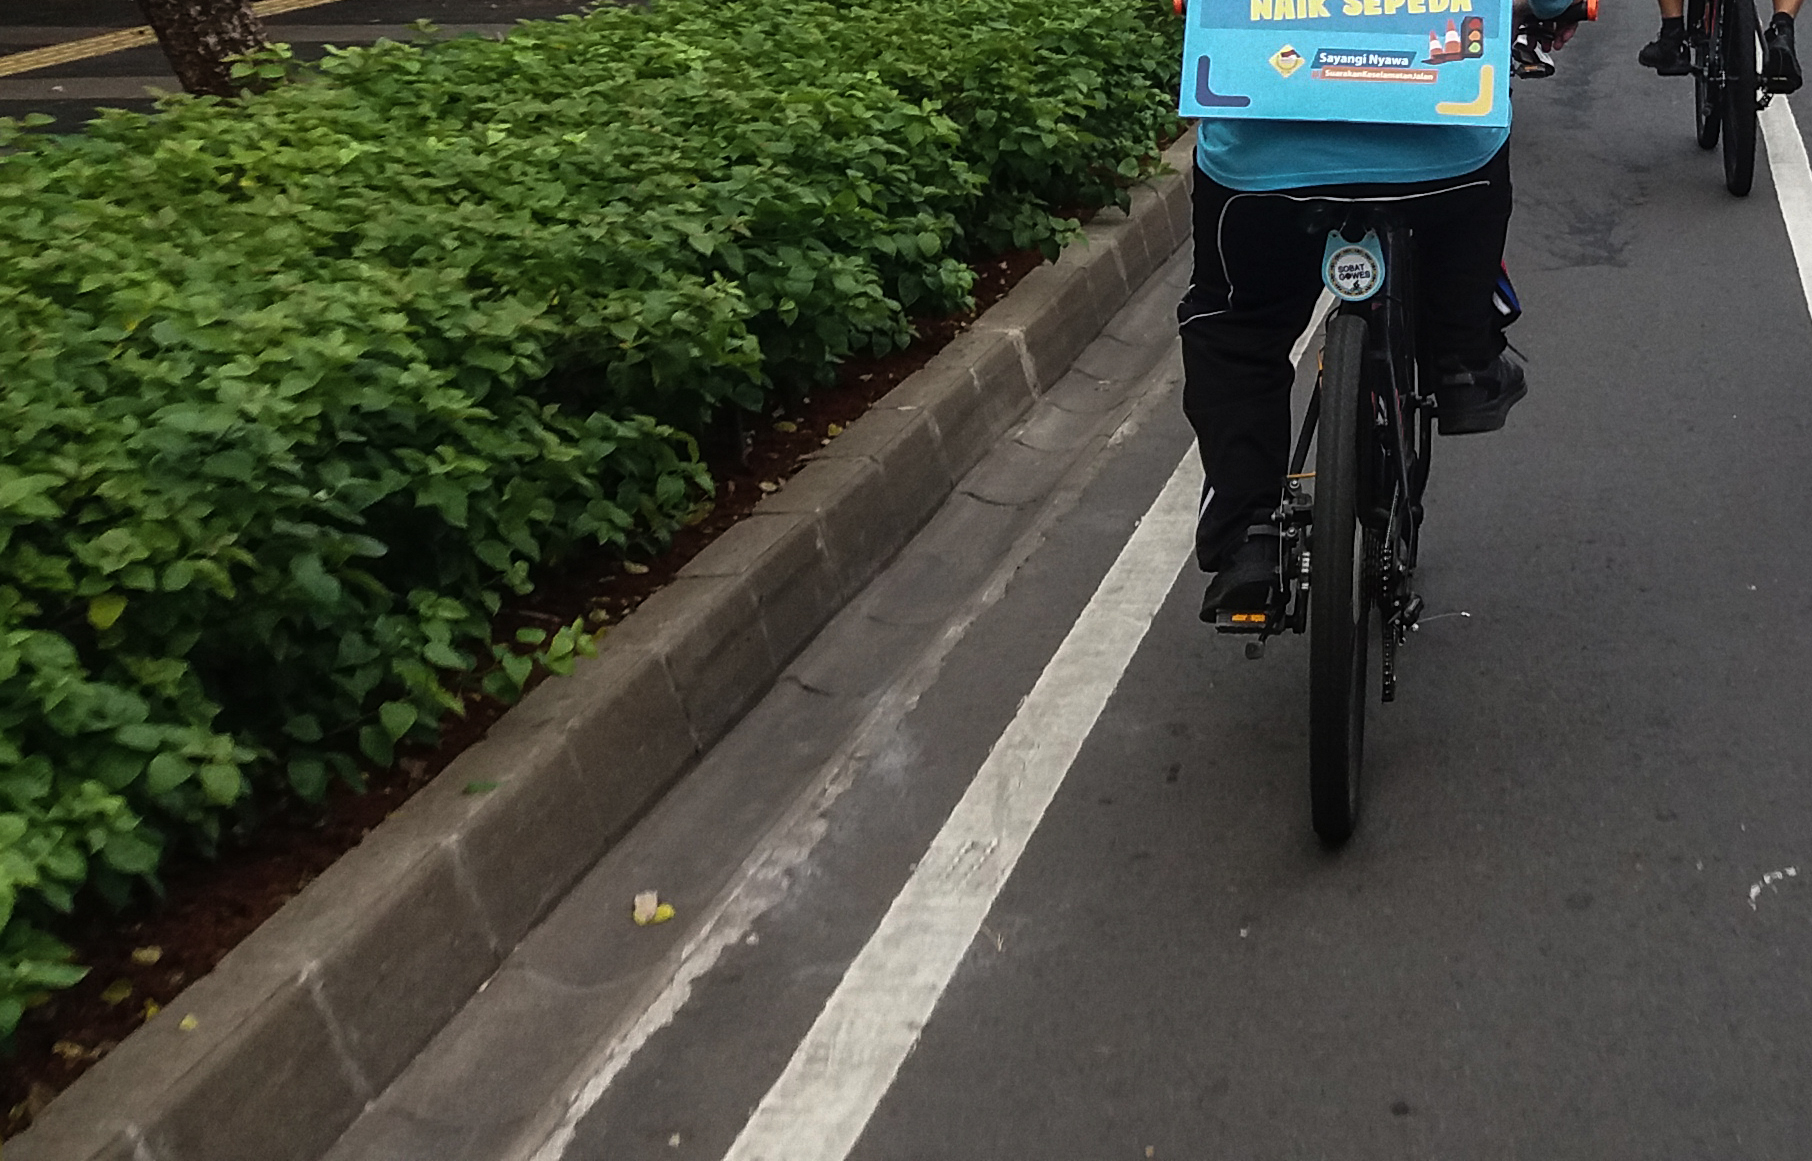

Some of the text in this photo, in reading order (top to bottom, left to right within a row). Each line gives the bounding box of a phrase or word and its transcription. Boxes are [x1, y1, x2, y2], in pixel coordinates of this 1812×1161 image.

[1319, 52, 1409, 67] Sayangi Nyawa
[1338, 263, 1365, 273] SOBAT
[1338, 271, 1371, 281] GOWES
